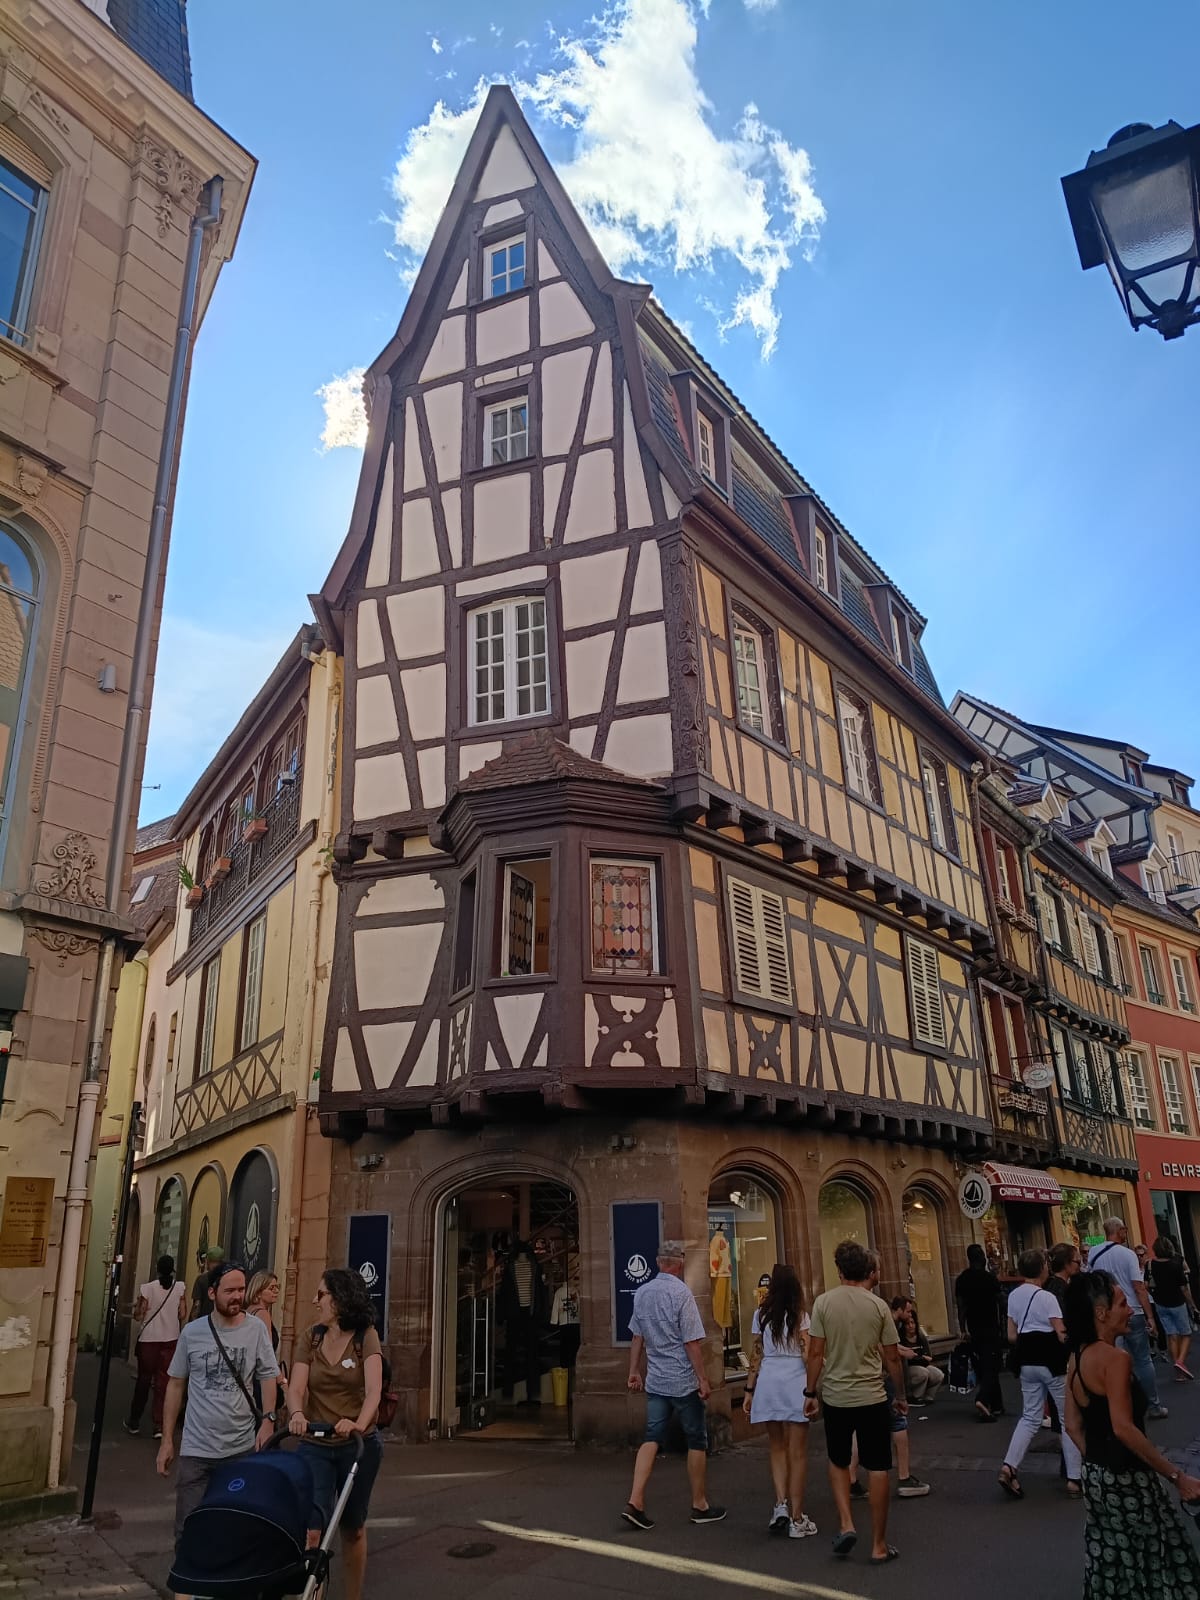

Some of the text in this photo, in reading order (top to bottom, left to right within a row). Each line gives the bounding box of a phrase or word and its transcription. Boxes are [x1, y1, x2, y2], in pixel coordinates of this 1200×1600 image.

[961, 1197, 987, 1215] PETIT BATEAU
[624, 1267, 652, 1284] PETIT BATEAU
